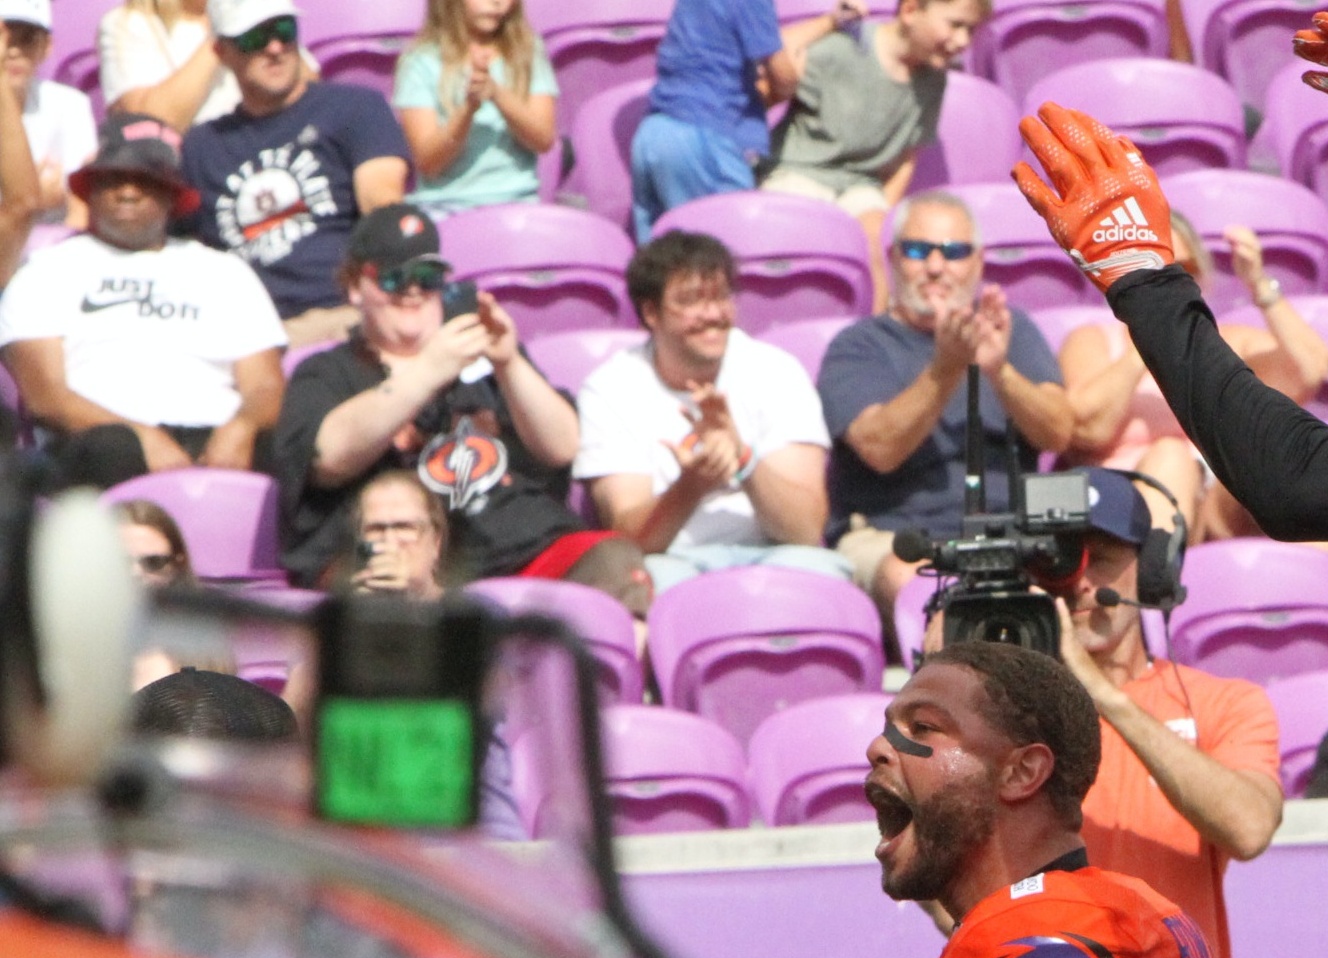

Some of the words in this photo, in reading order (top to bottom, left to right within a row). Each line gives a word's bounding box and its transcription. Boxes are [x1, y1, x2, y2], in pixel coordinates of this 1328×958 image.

[1093, 225, 1158, 243] adidas
[98, 278, 154, 302] JUST
[139, 300, 175, 319] DO
[181, 302, 199, 320] IT
